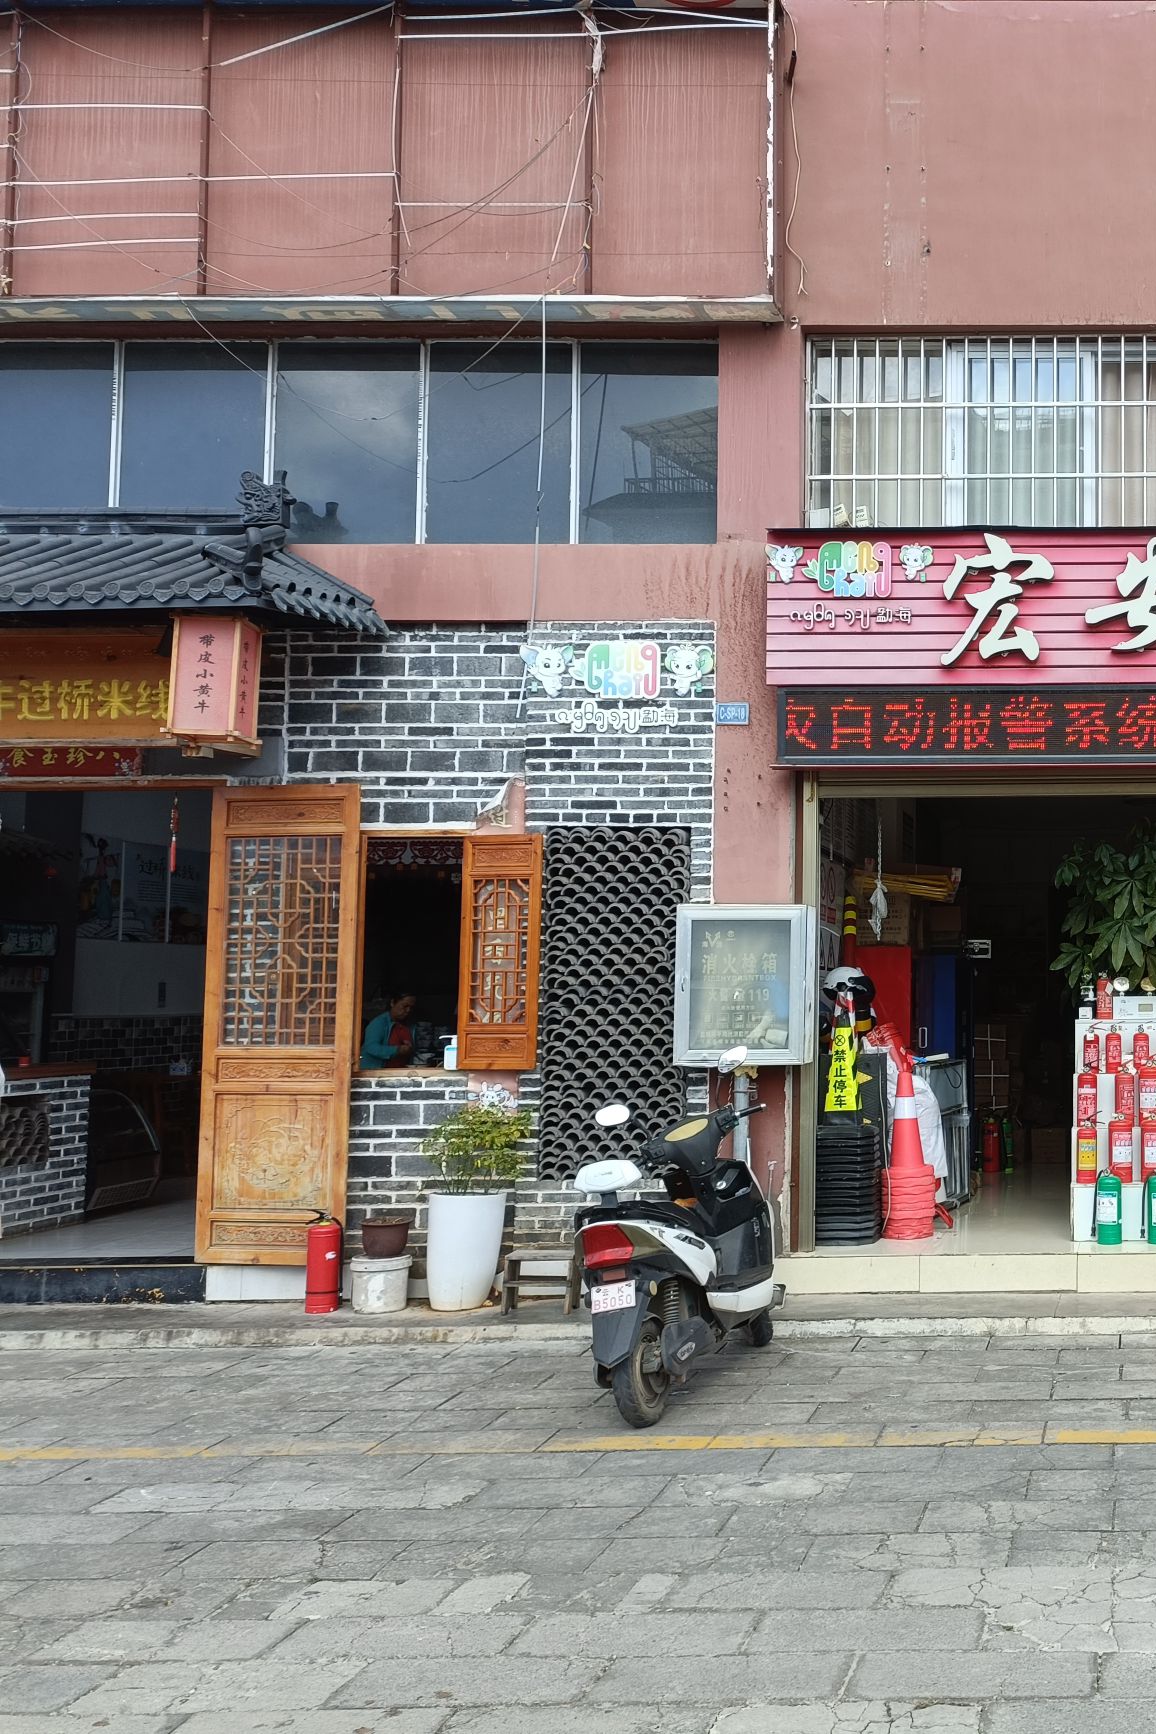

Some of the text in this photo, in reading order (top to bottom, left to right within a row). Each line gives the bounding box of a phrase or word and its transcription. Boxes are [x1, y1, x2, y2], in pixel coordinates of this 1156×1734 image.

[193, 633, 216, 714] 带皮小黄牛
[702, 952, 777, 975] 消火栓箱
[833, 1049, 848, 1109] 禁止停车
